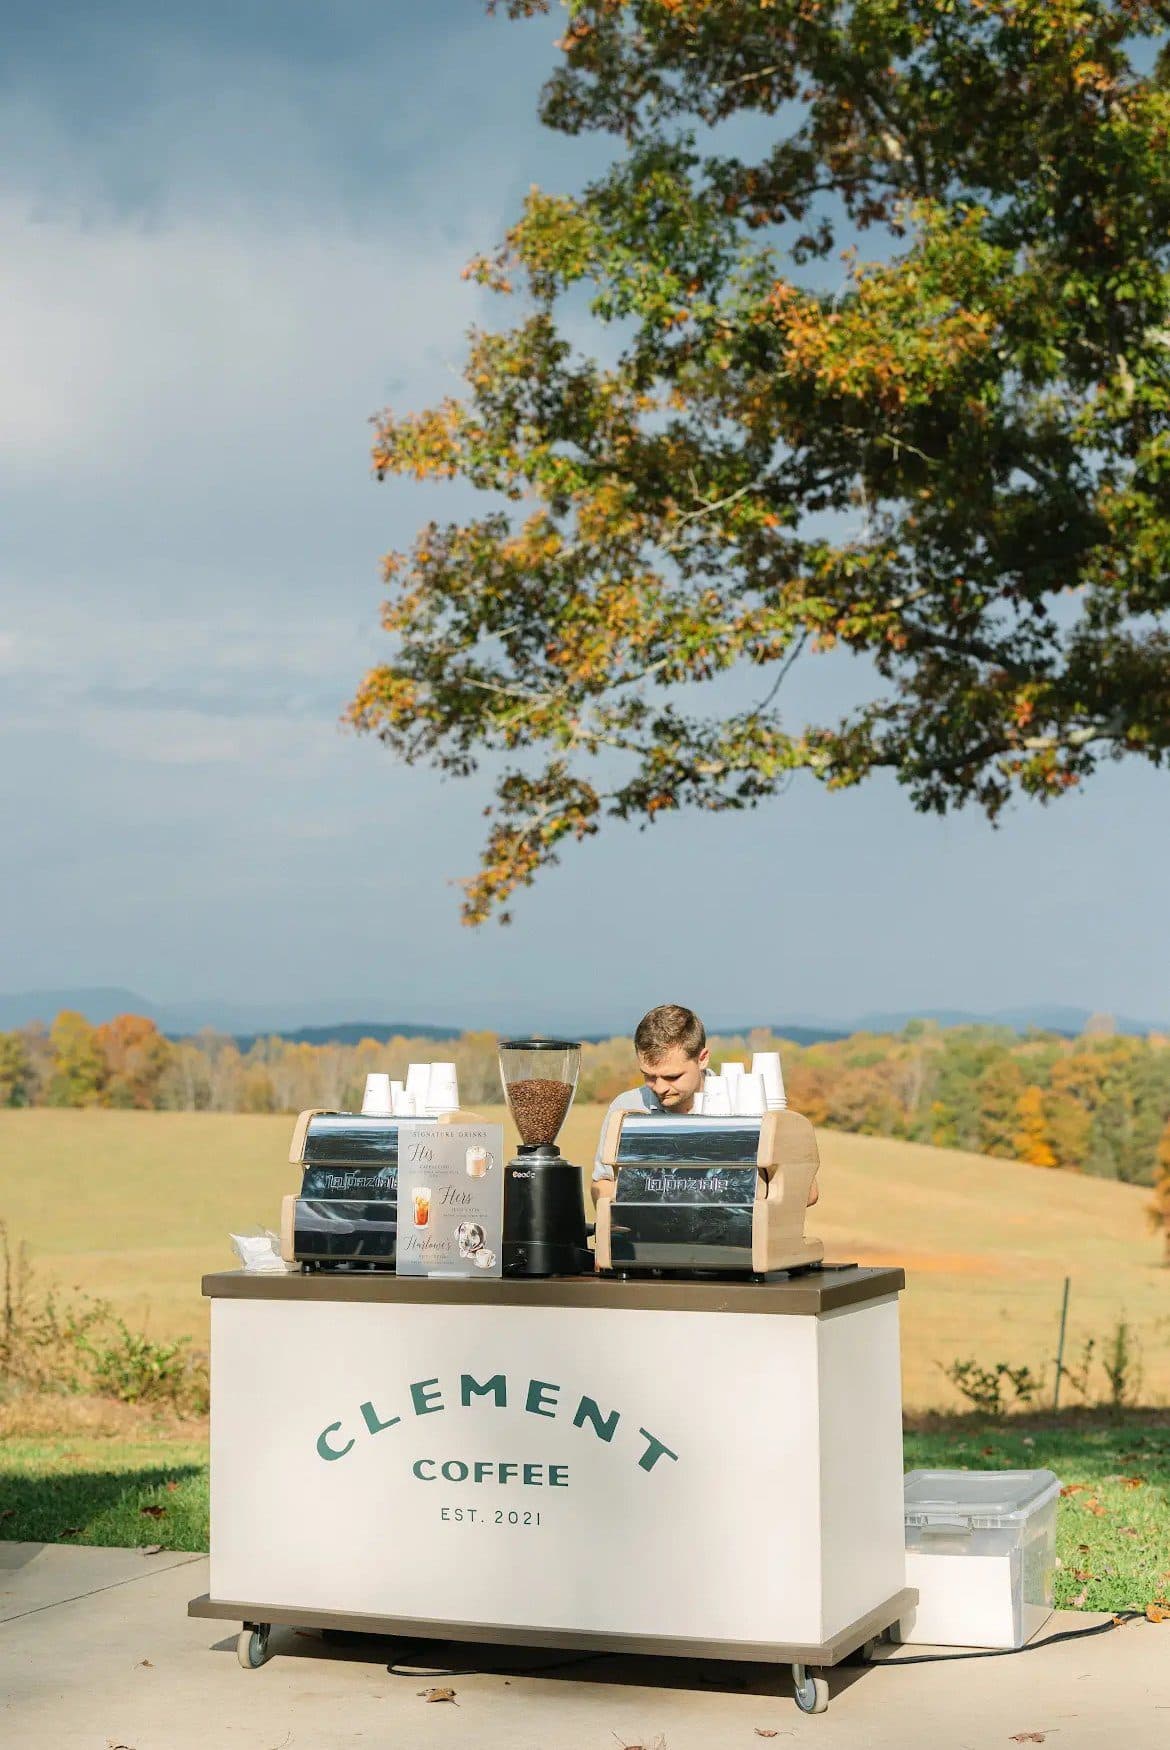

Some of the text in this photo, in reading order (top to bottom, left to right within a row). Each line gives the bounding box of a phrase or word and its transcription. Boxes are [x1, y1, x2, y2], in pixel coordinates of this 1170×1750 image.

[412, 1130, 488, 1138] SIGNATURE DRINKS
[408, 1142, 434, 1162] His
[438, 1184, 472, 1205] Hers
[316, 1374, 679, 1473] CLEMENT
[412, 1459, 569, 1487] COFFEE
[441, 1507, 541, 1526] EST. 2021
